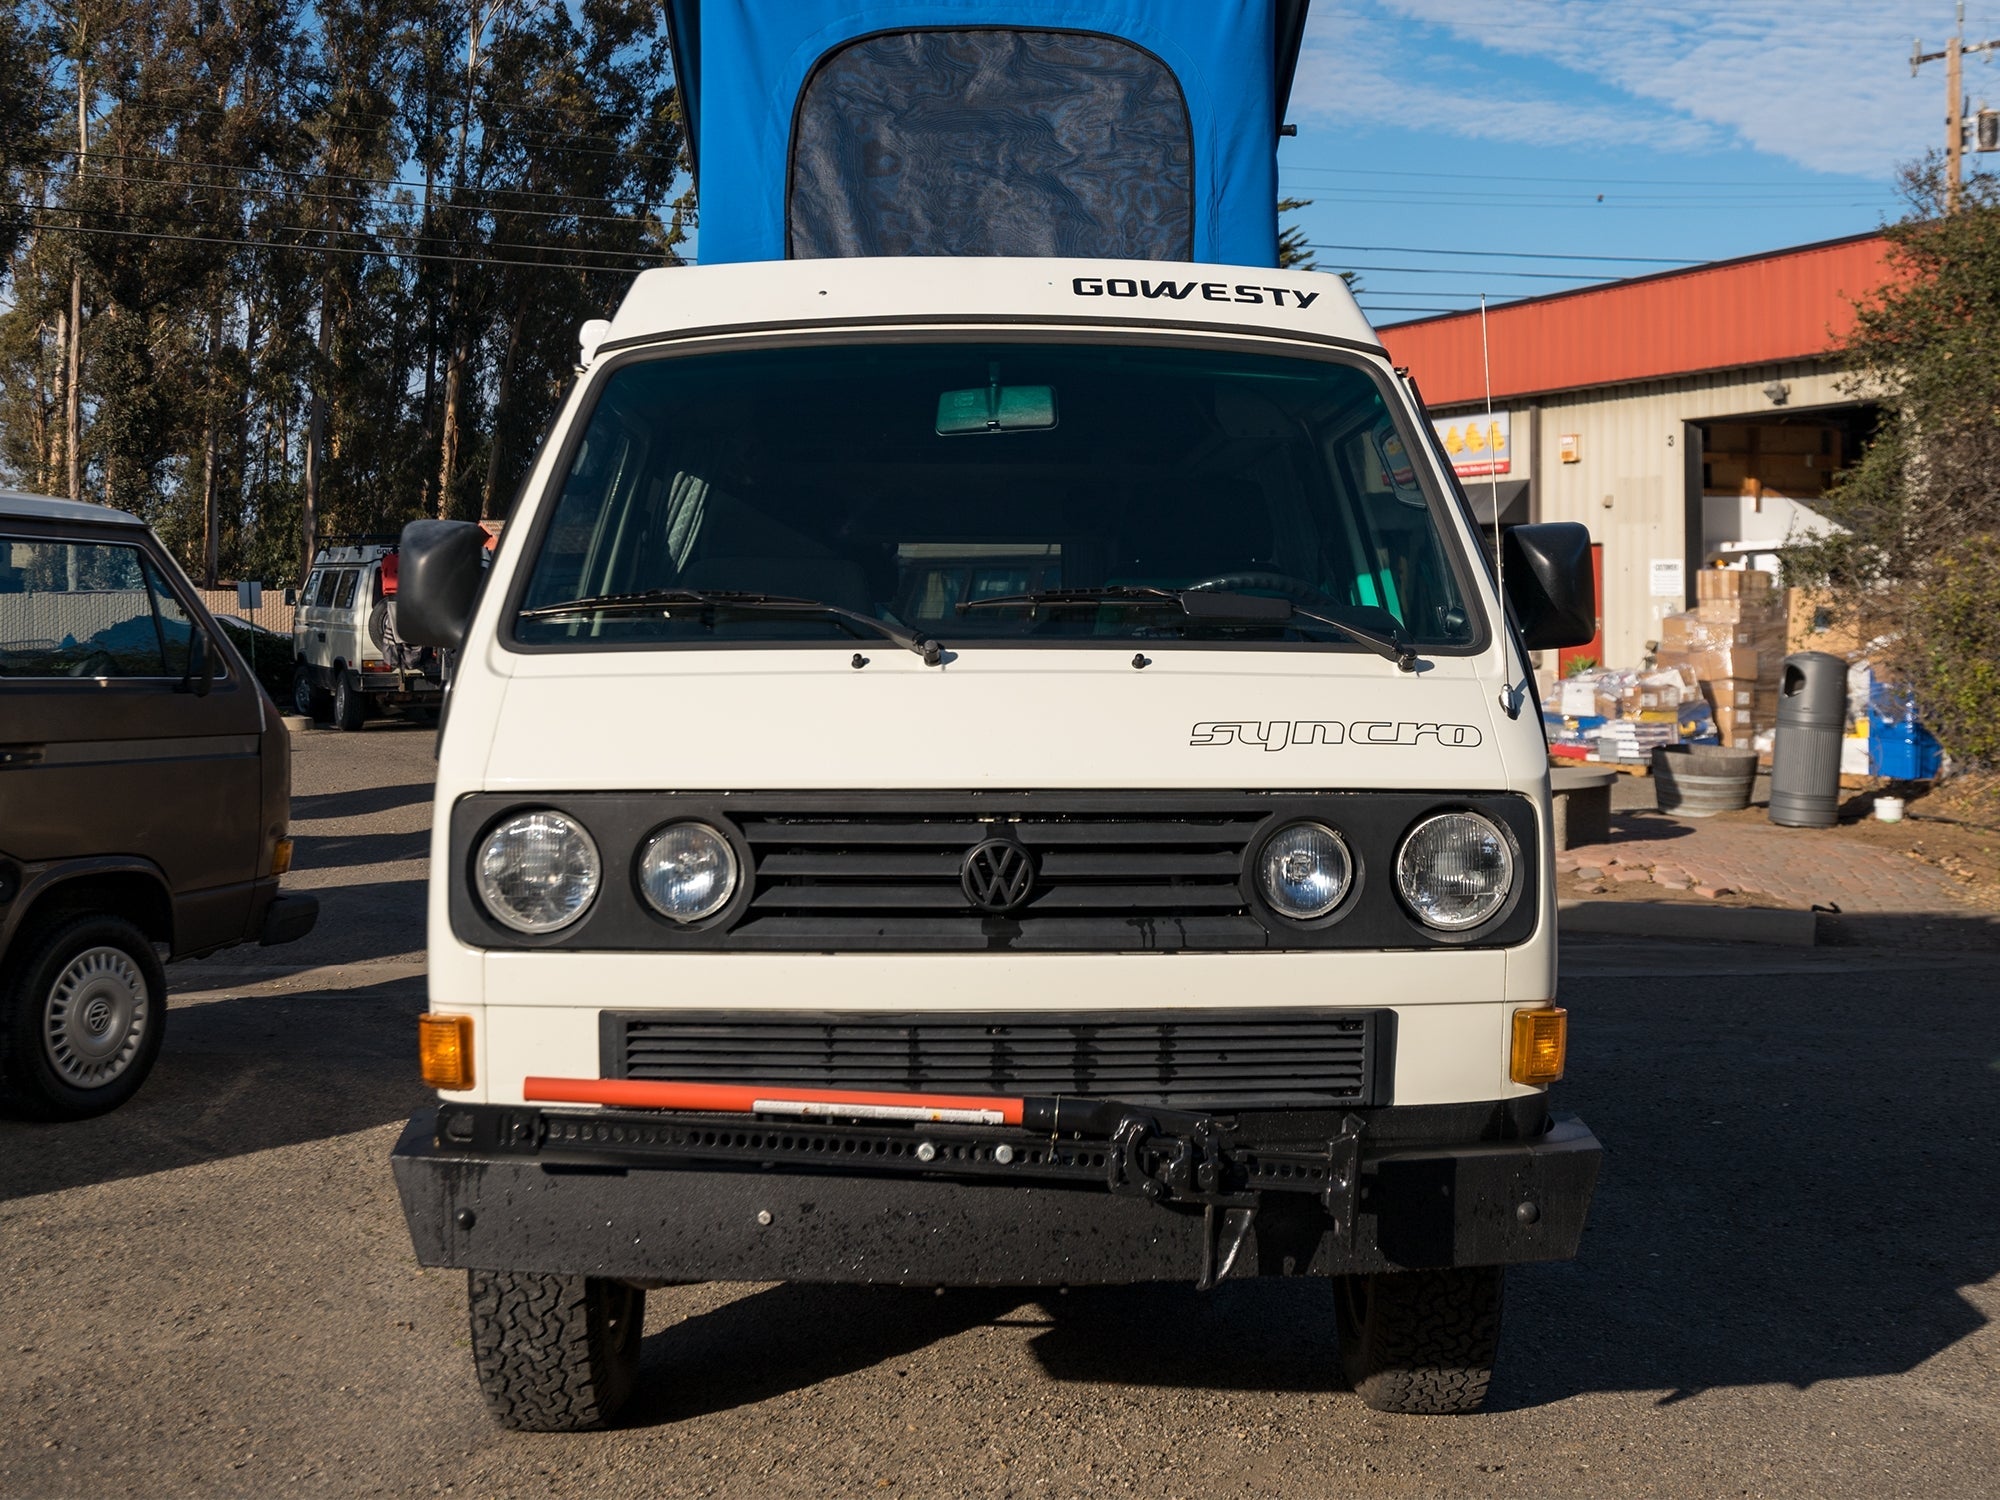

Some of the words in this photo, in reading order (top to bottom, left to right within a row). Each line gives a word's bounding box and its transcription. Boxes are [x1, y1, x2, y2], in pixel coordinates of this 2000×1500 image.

[1072, 277, 1320, 309] GOWESTY
[1667, 434, 1675, 447] 3
[1190, 721, 1482, 752] syncro
